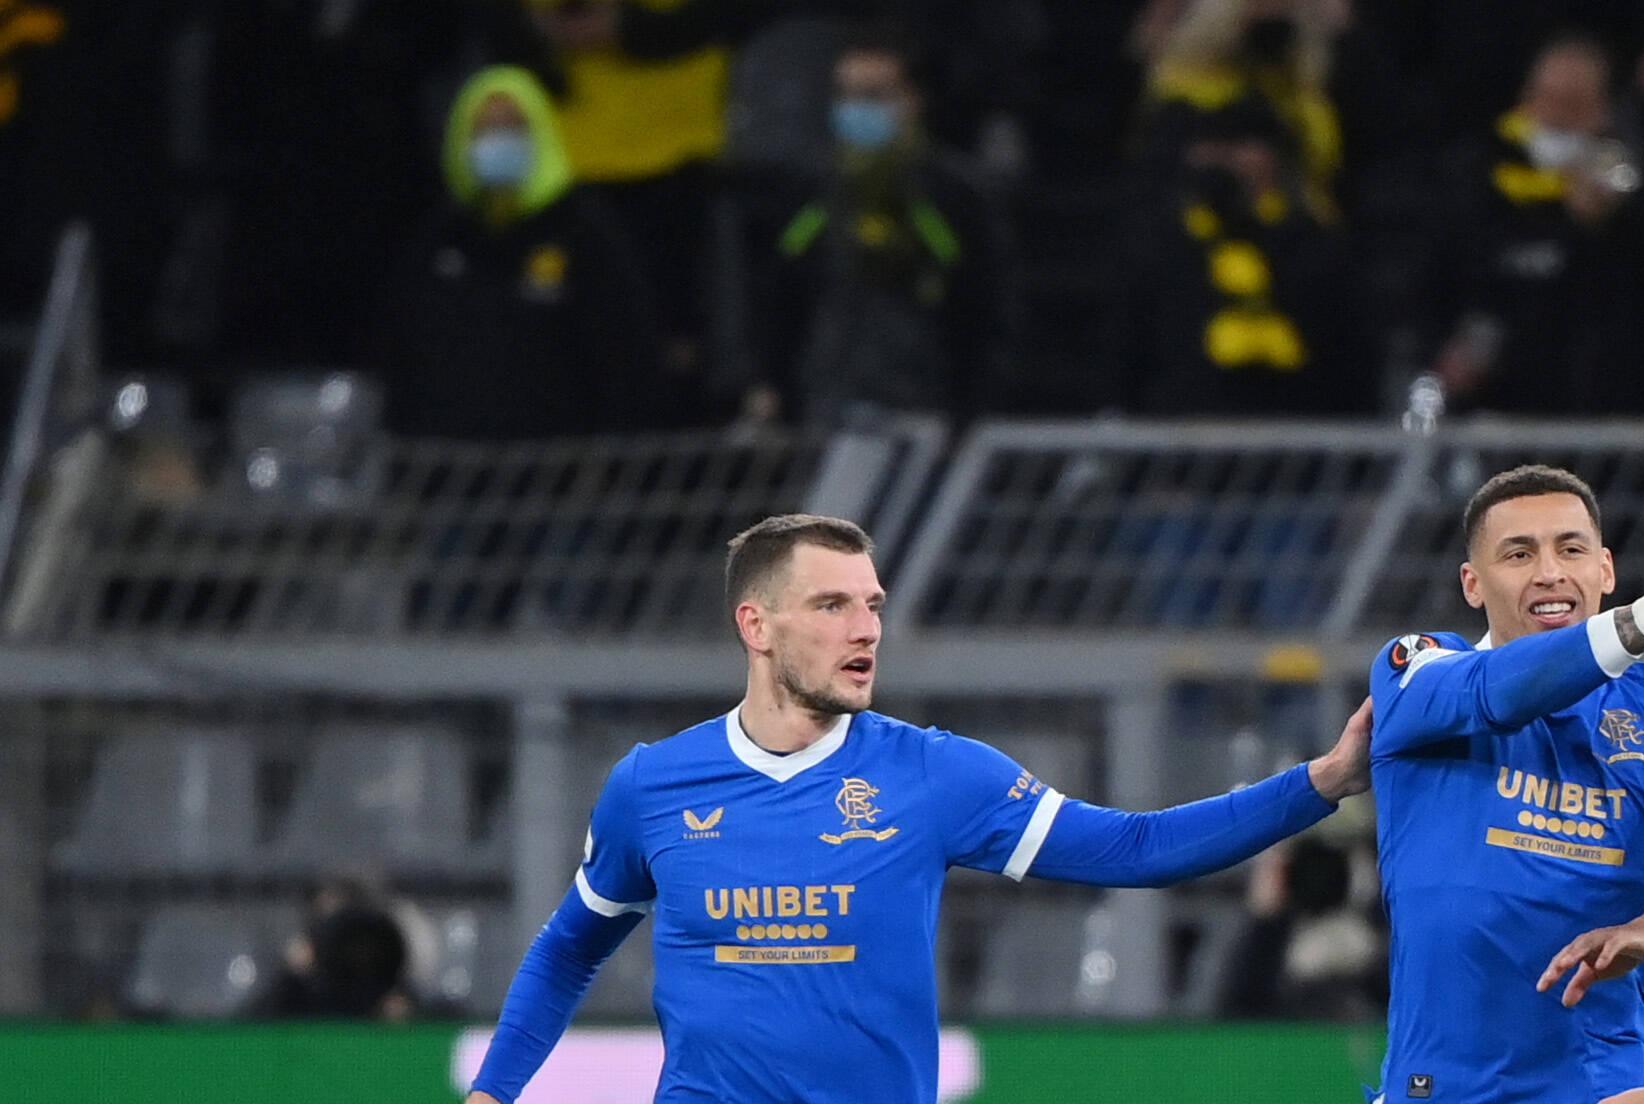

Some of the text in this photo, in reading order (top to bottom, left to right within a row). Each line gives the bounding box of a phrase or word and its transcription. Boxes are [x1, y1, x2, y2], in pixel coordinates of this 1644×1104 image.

[1497, 766, 1627, 819] UNIBET
[1513, 836, 1602, 860] SET YOUR LIMITS
[704, 885, 856, 920] UNIBET
[738, 950, 829, 960] SET YOUR LIMITS
